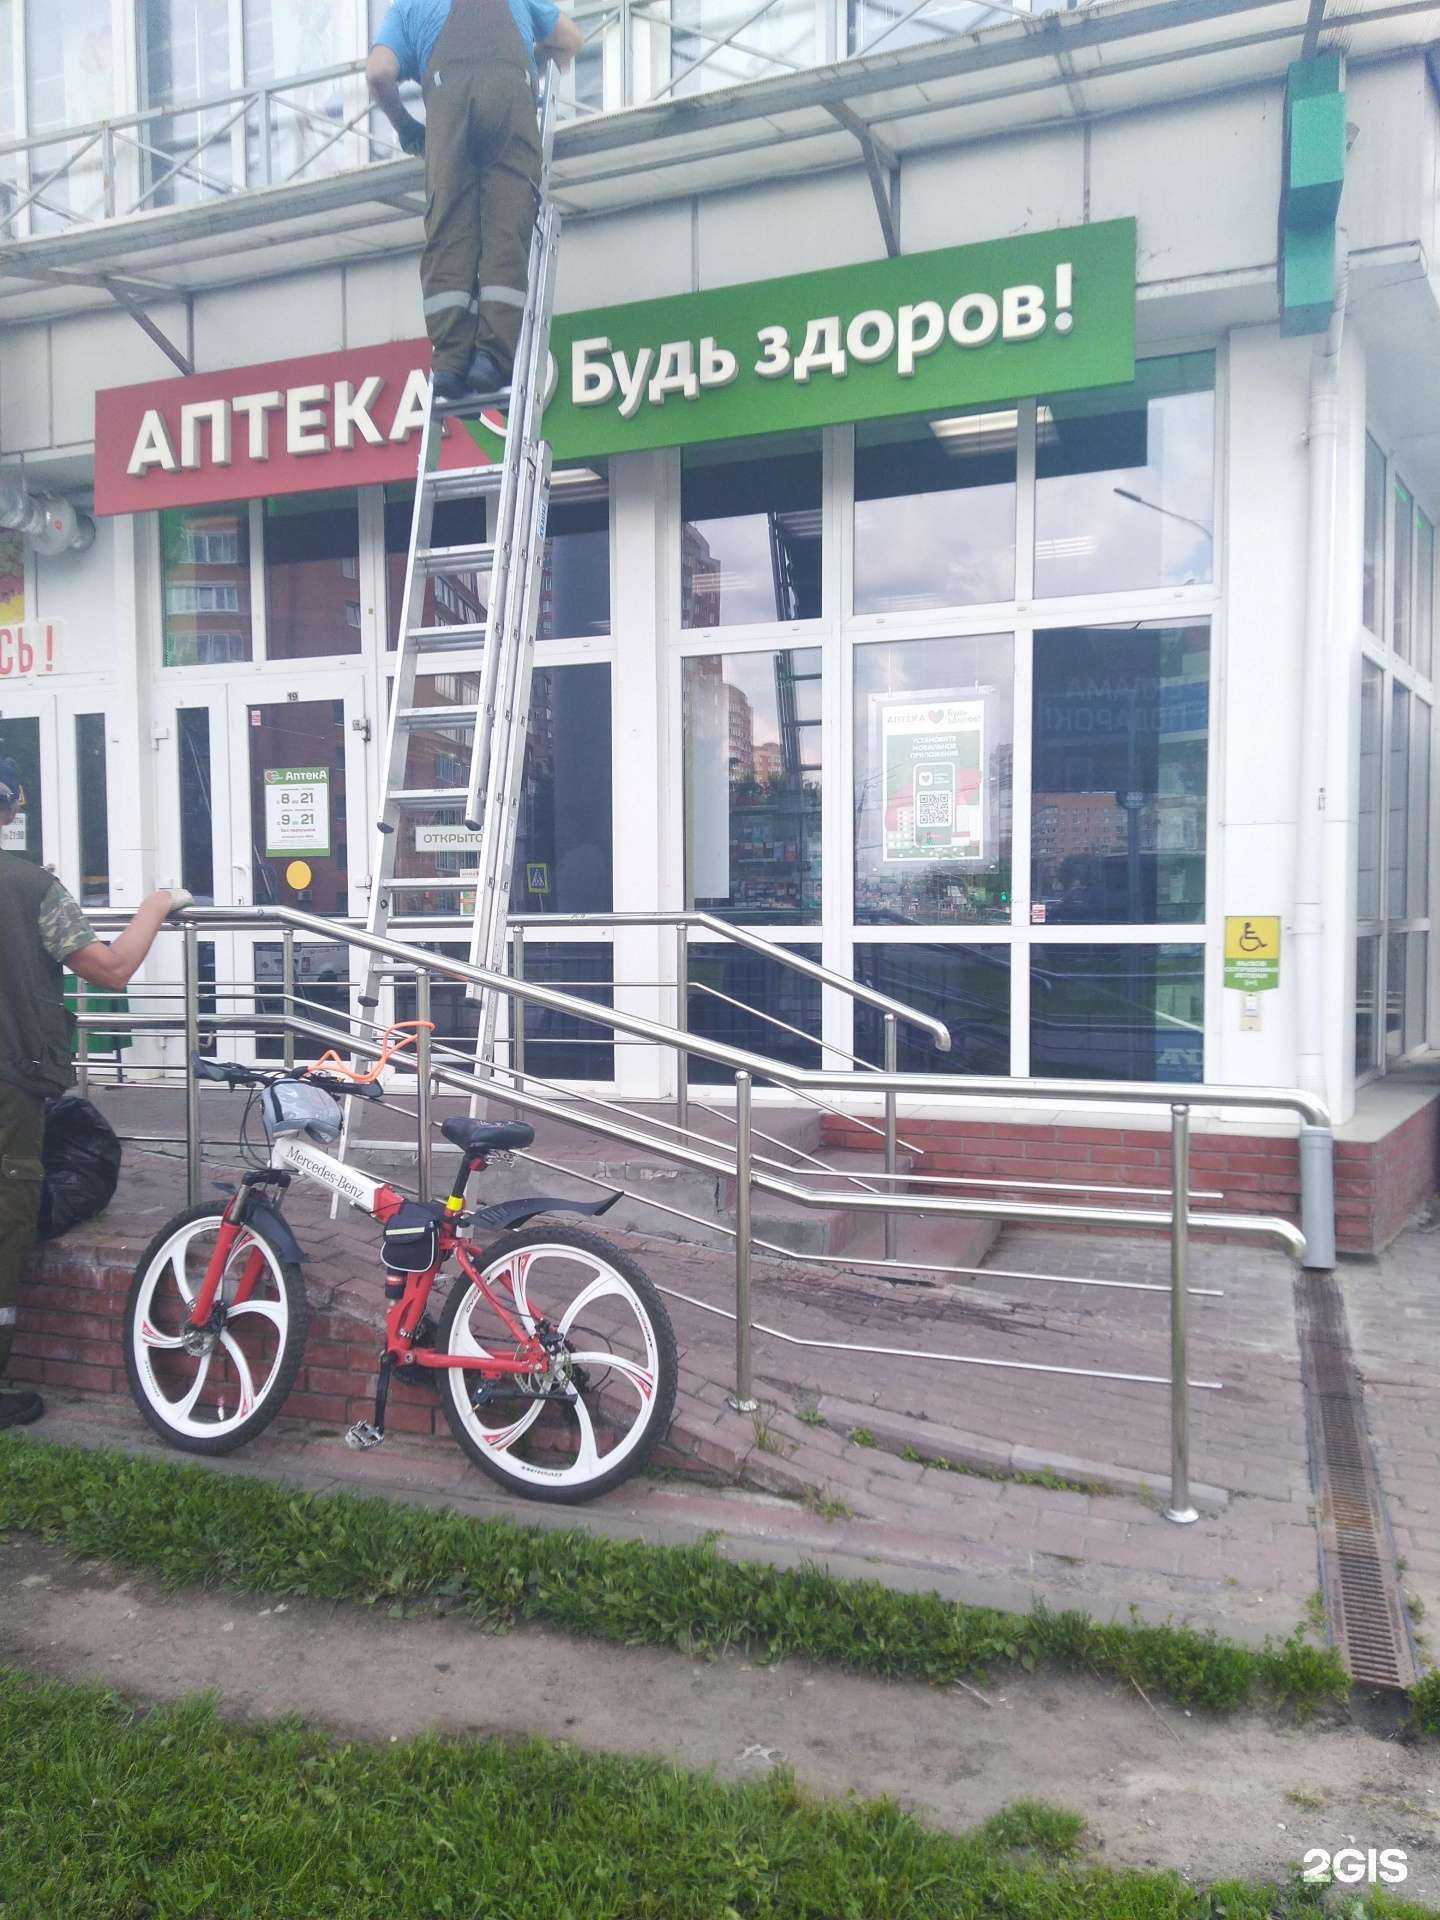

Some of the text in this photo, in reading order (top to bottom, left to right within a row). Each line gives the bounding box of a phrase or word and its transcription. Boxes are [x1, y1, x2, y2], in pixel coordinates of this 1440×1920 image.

[570, 262, 1075, 420] Будь здоров!
[126, 367, 449, 477] АПТЕКА
[281, 793, 290, 804] 8
[300, 792, 314, 804] 21
[281, 814, 290, 825] 9
[300, 813, 314, 825] 21
[423, 833, 483, 844] ОТКРЫТО
[286, 1146, 365, 1200] Mercedes-Benz
